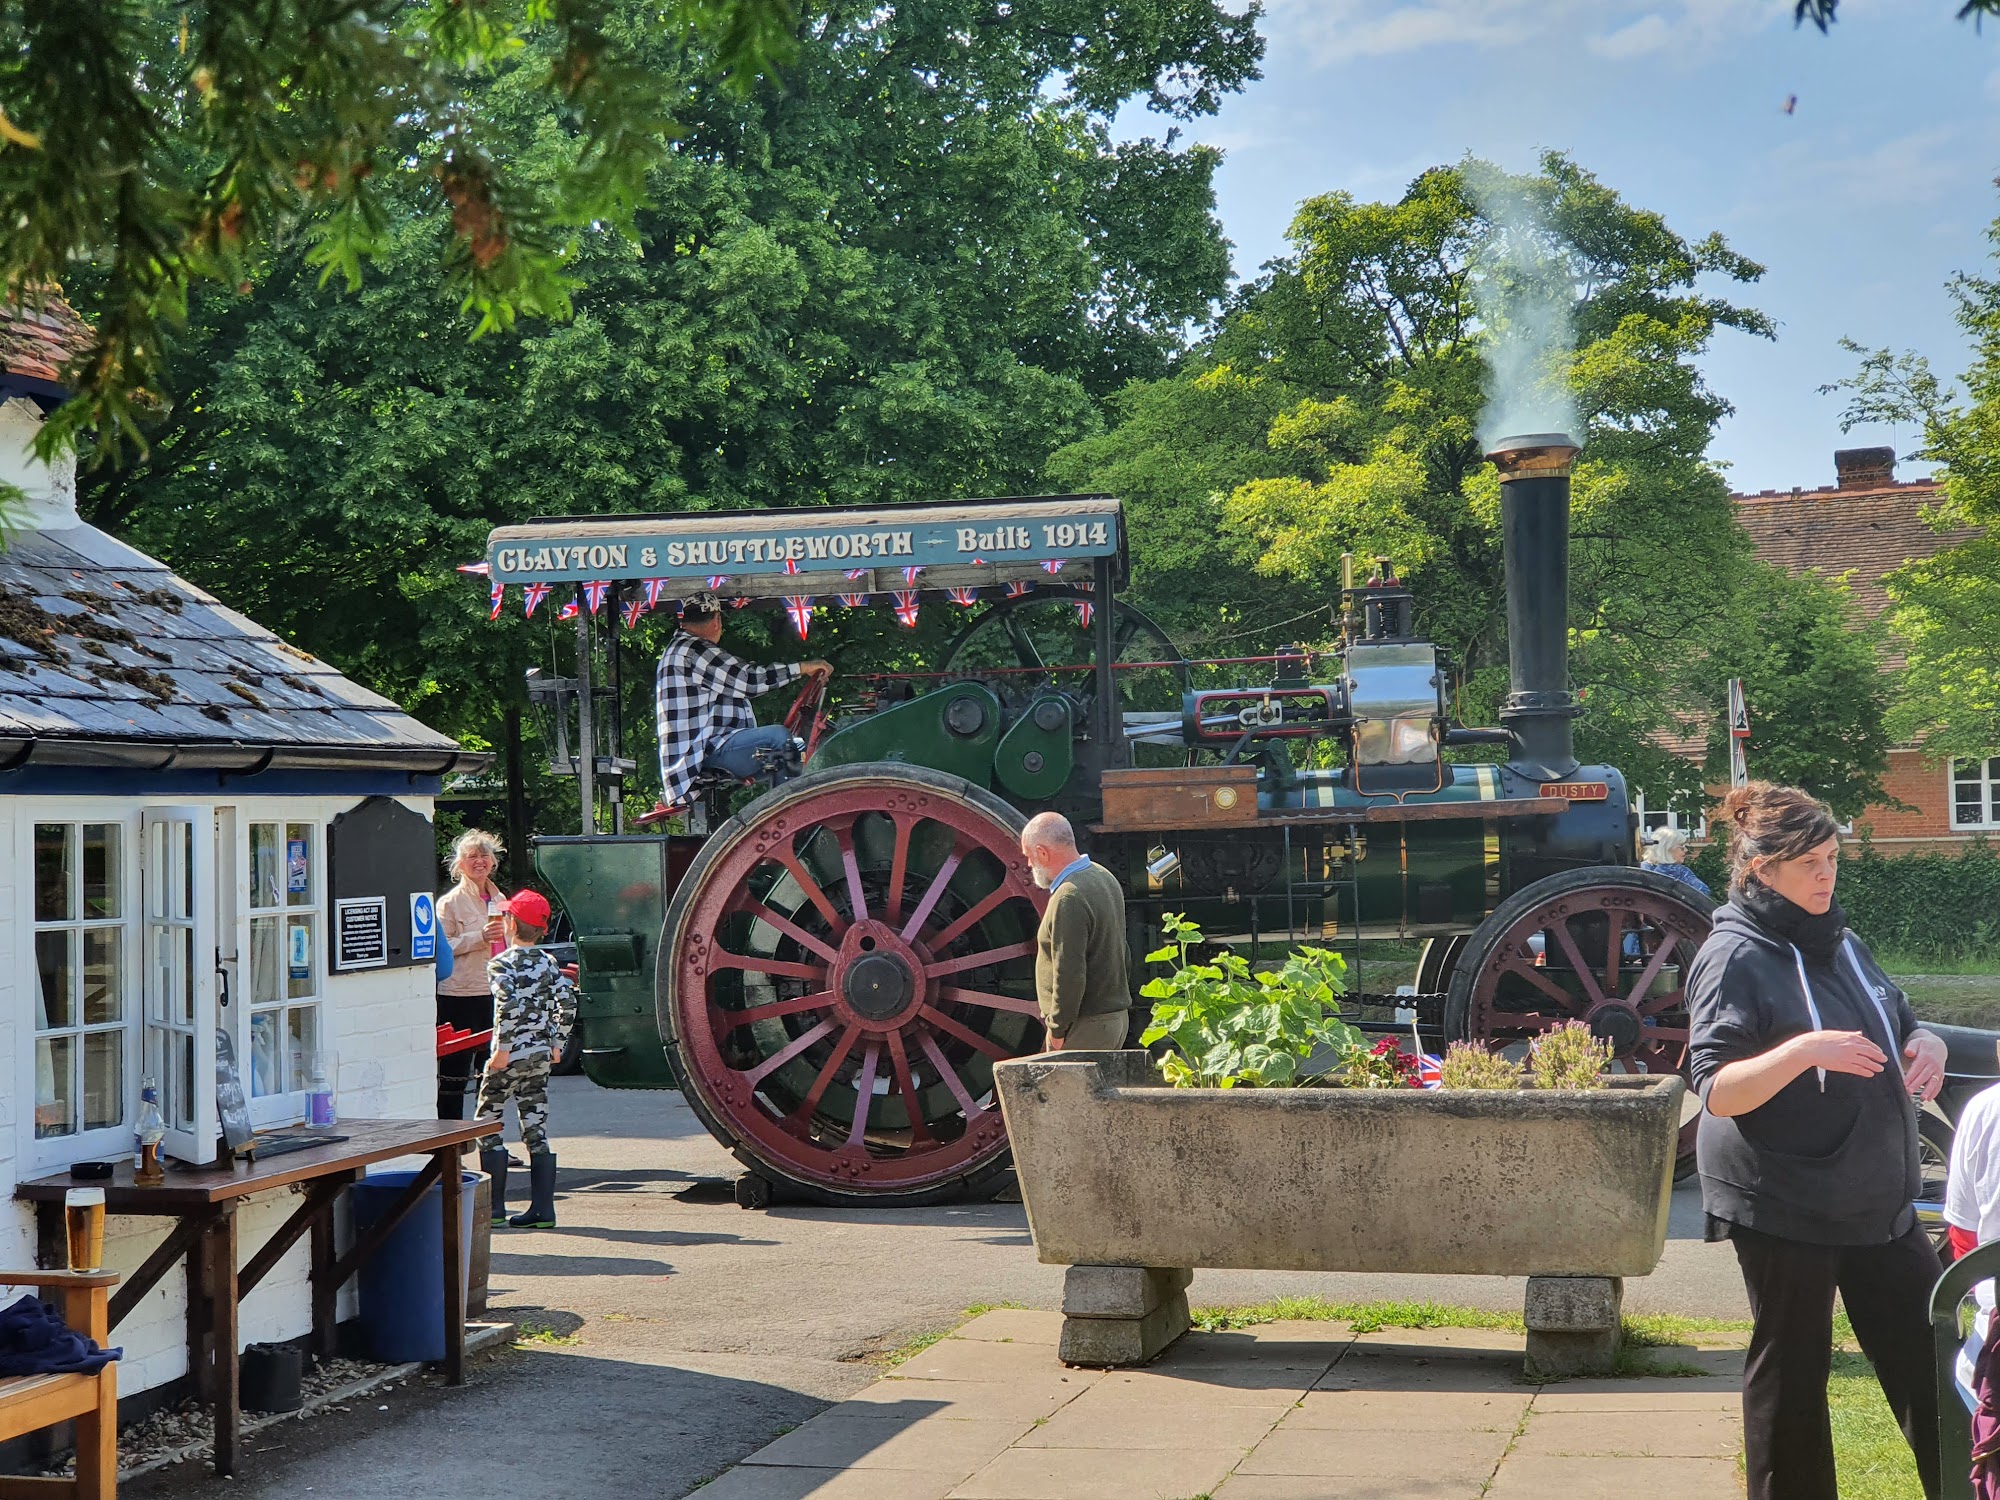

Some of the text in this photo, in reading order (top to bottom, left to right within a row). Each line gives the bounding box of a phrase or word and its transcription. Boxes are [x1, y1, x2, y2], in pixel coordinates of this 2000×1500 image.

[497, 522, 1108, 573] CLAYTON & SHUTTLEWORTH Built 1914
[1549, 785, 1598, 797] DUSTY
